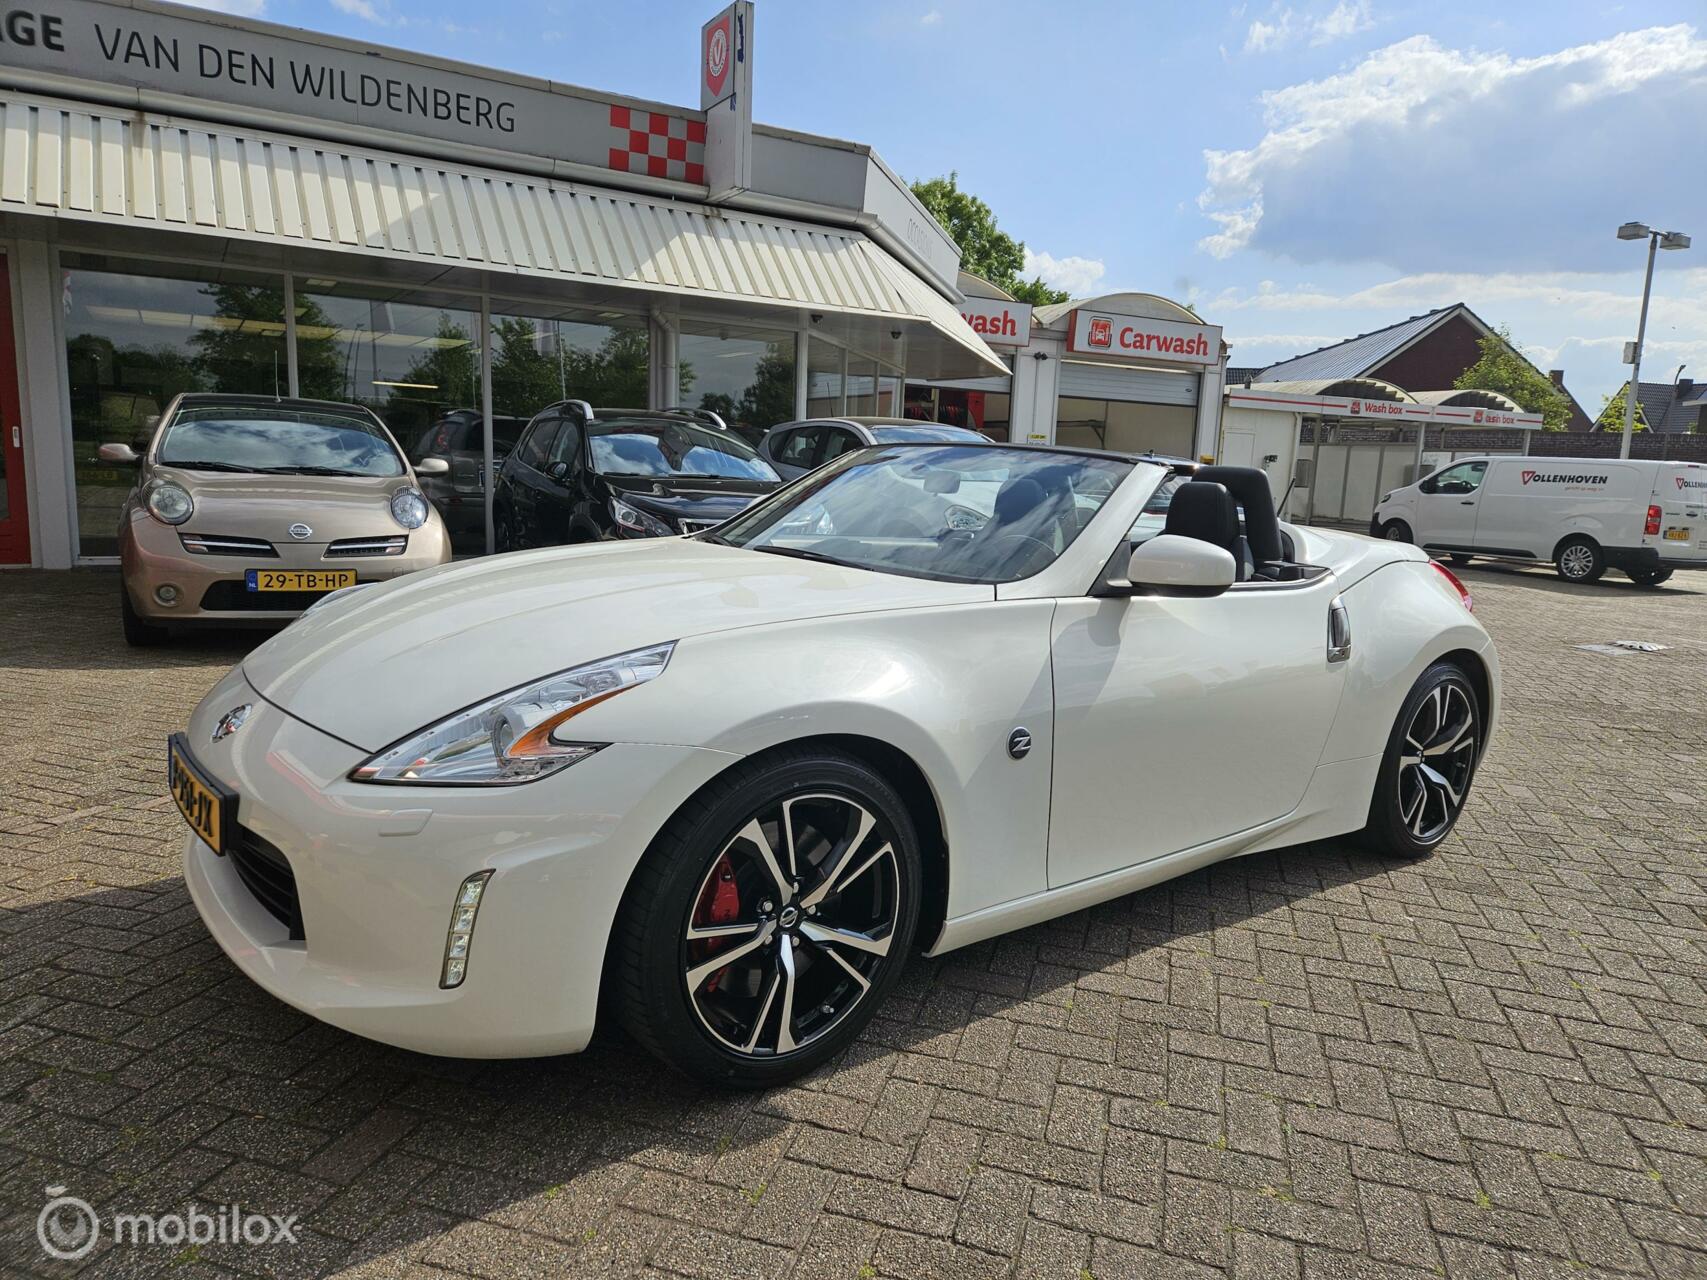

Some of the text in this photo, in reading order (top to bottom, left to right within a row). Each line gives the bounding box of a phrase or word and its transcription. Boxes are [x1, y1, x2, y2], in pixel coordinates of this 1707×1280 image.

[0, 9, 516, 133] GE VAN DEN WILDENBERG
[1119, 326, 1208, 356] Carwash
[1365, 401, 1403, 414] Wash box
[1521, 470, 1608, 485] VOLLENHOVEN
[263, 573, 349, 589] 29-TB-HP
